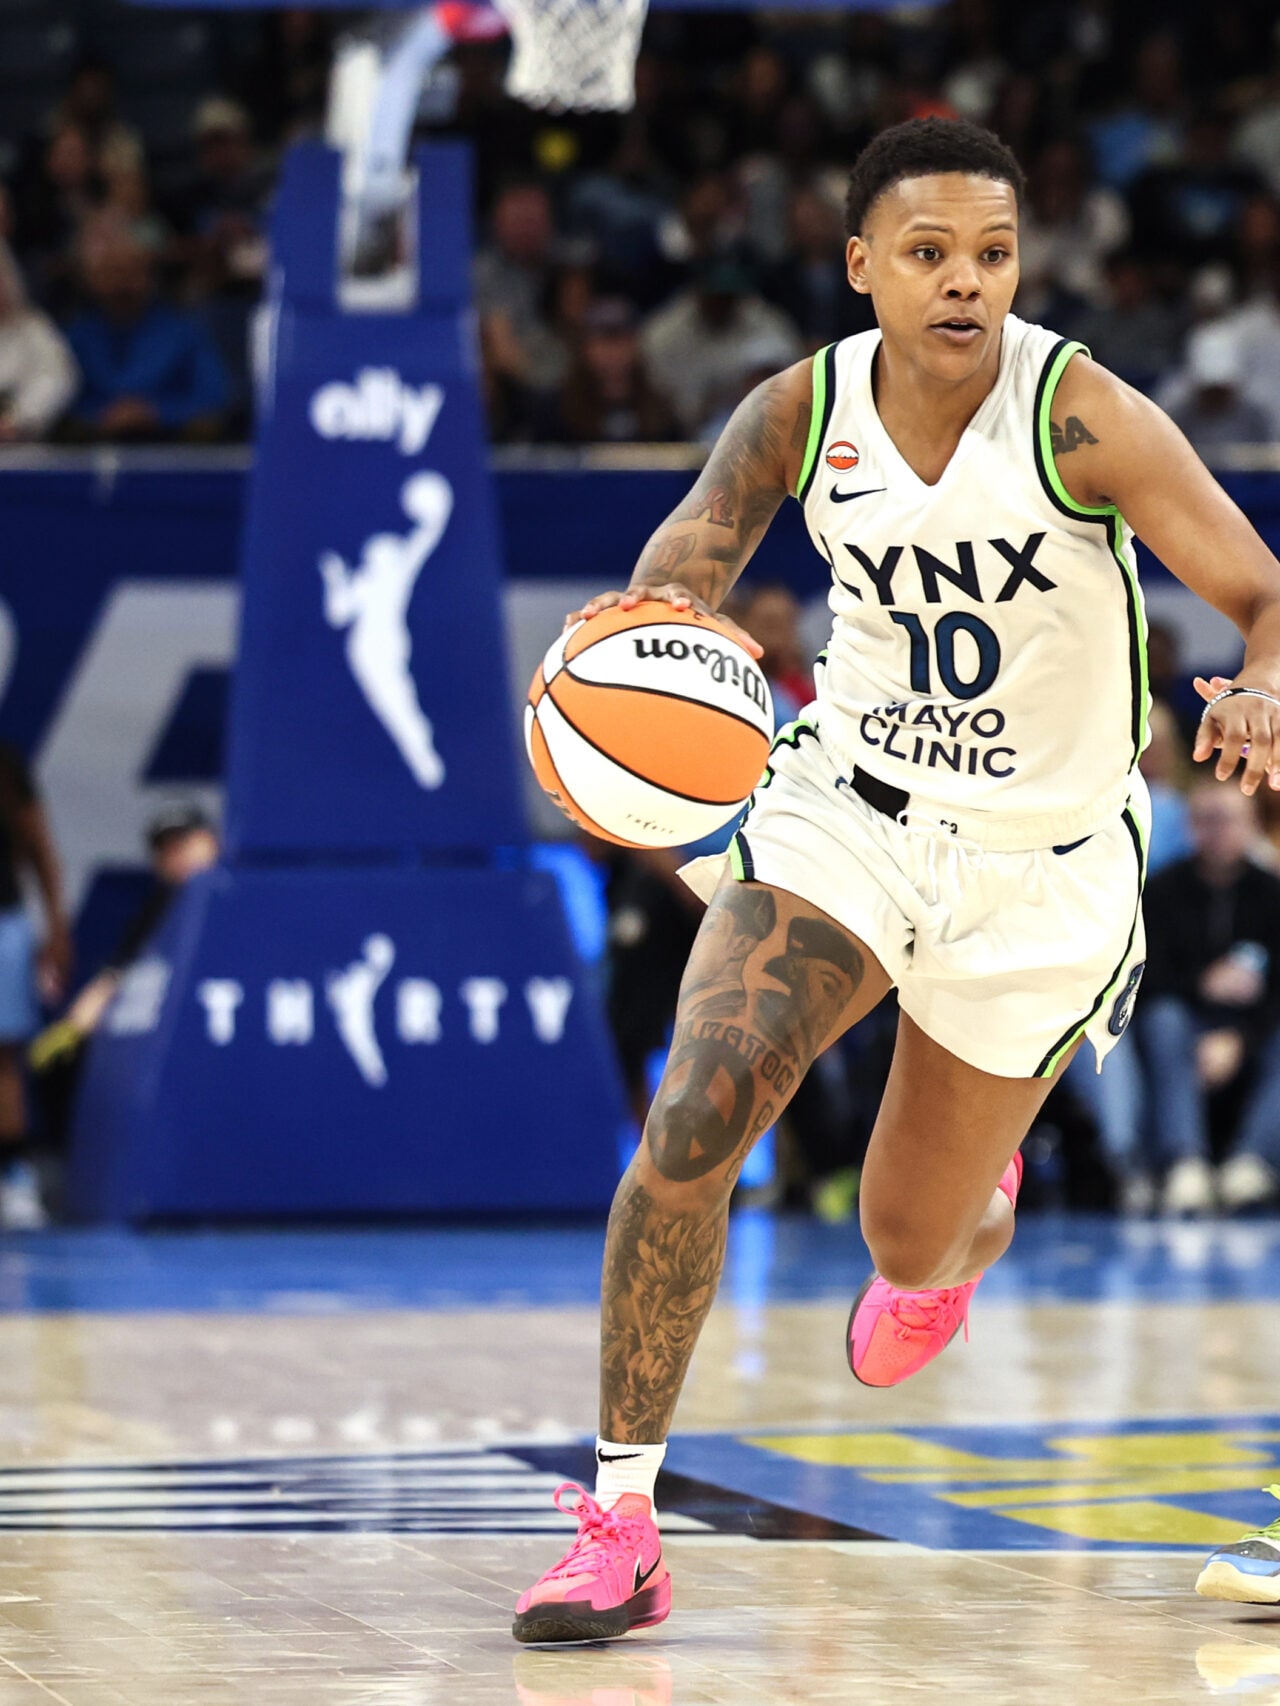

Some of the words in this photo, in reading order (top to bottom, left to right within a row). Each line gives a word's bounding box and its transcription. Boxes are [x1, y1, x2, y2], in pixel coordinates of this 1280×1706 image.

[633, 638, 768, 716] Wilson
[888, 610, 1001, 700] 10
[860, 713, 1017, 778] CLINIC
